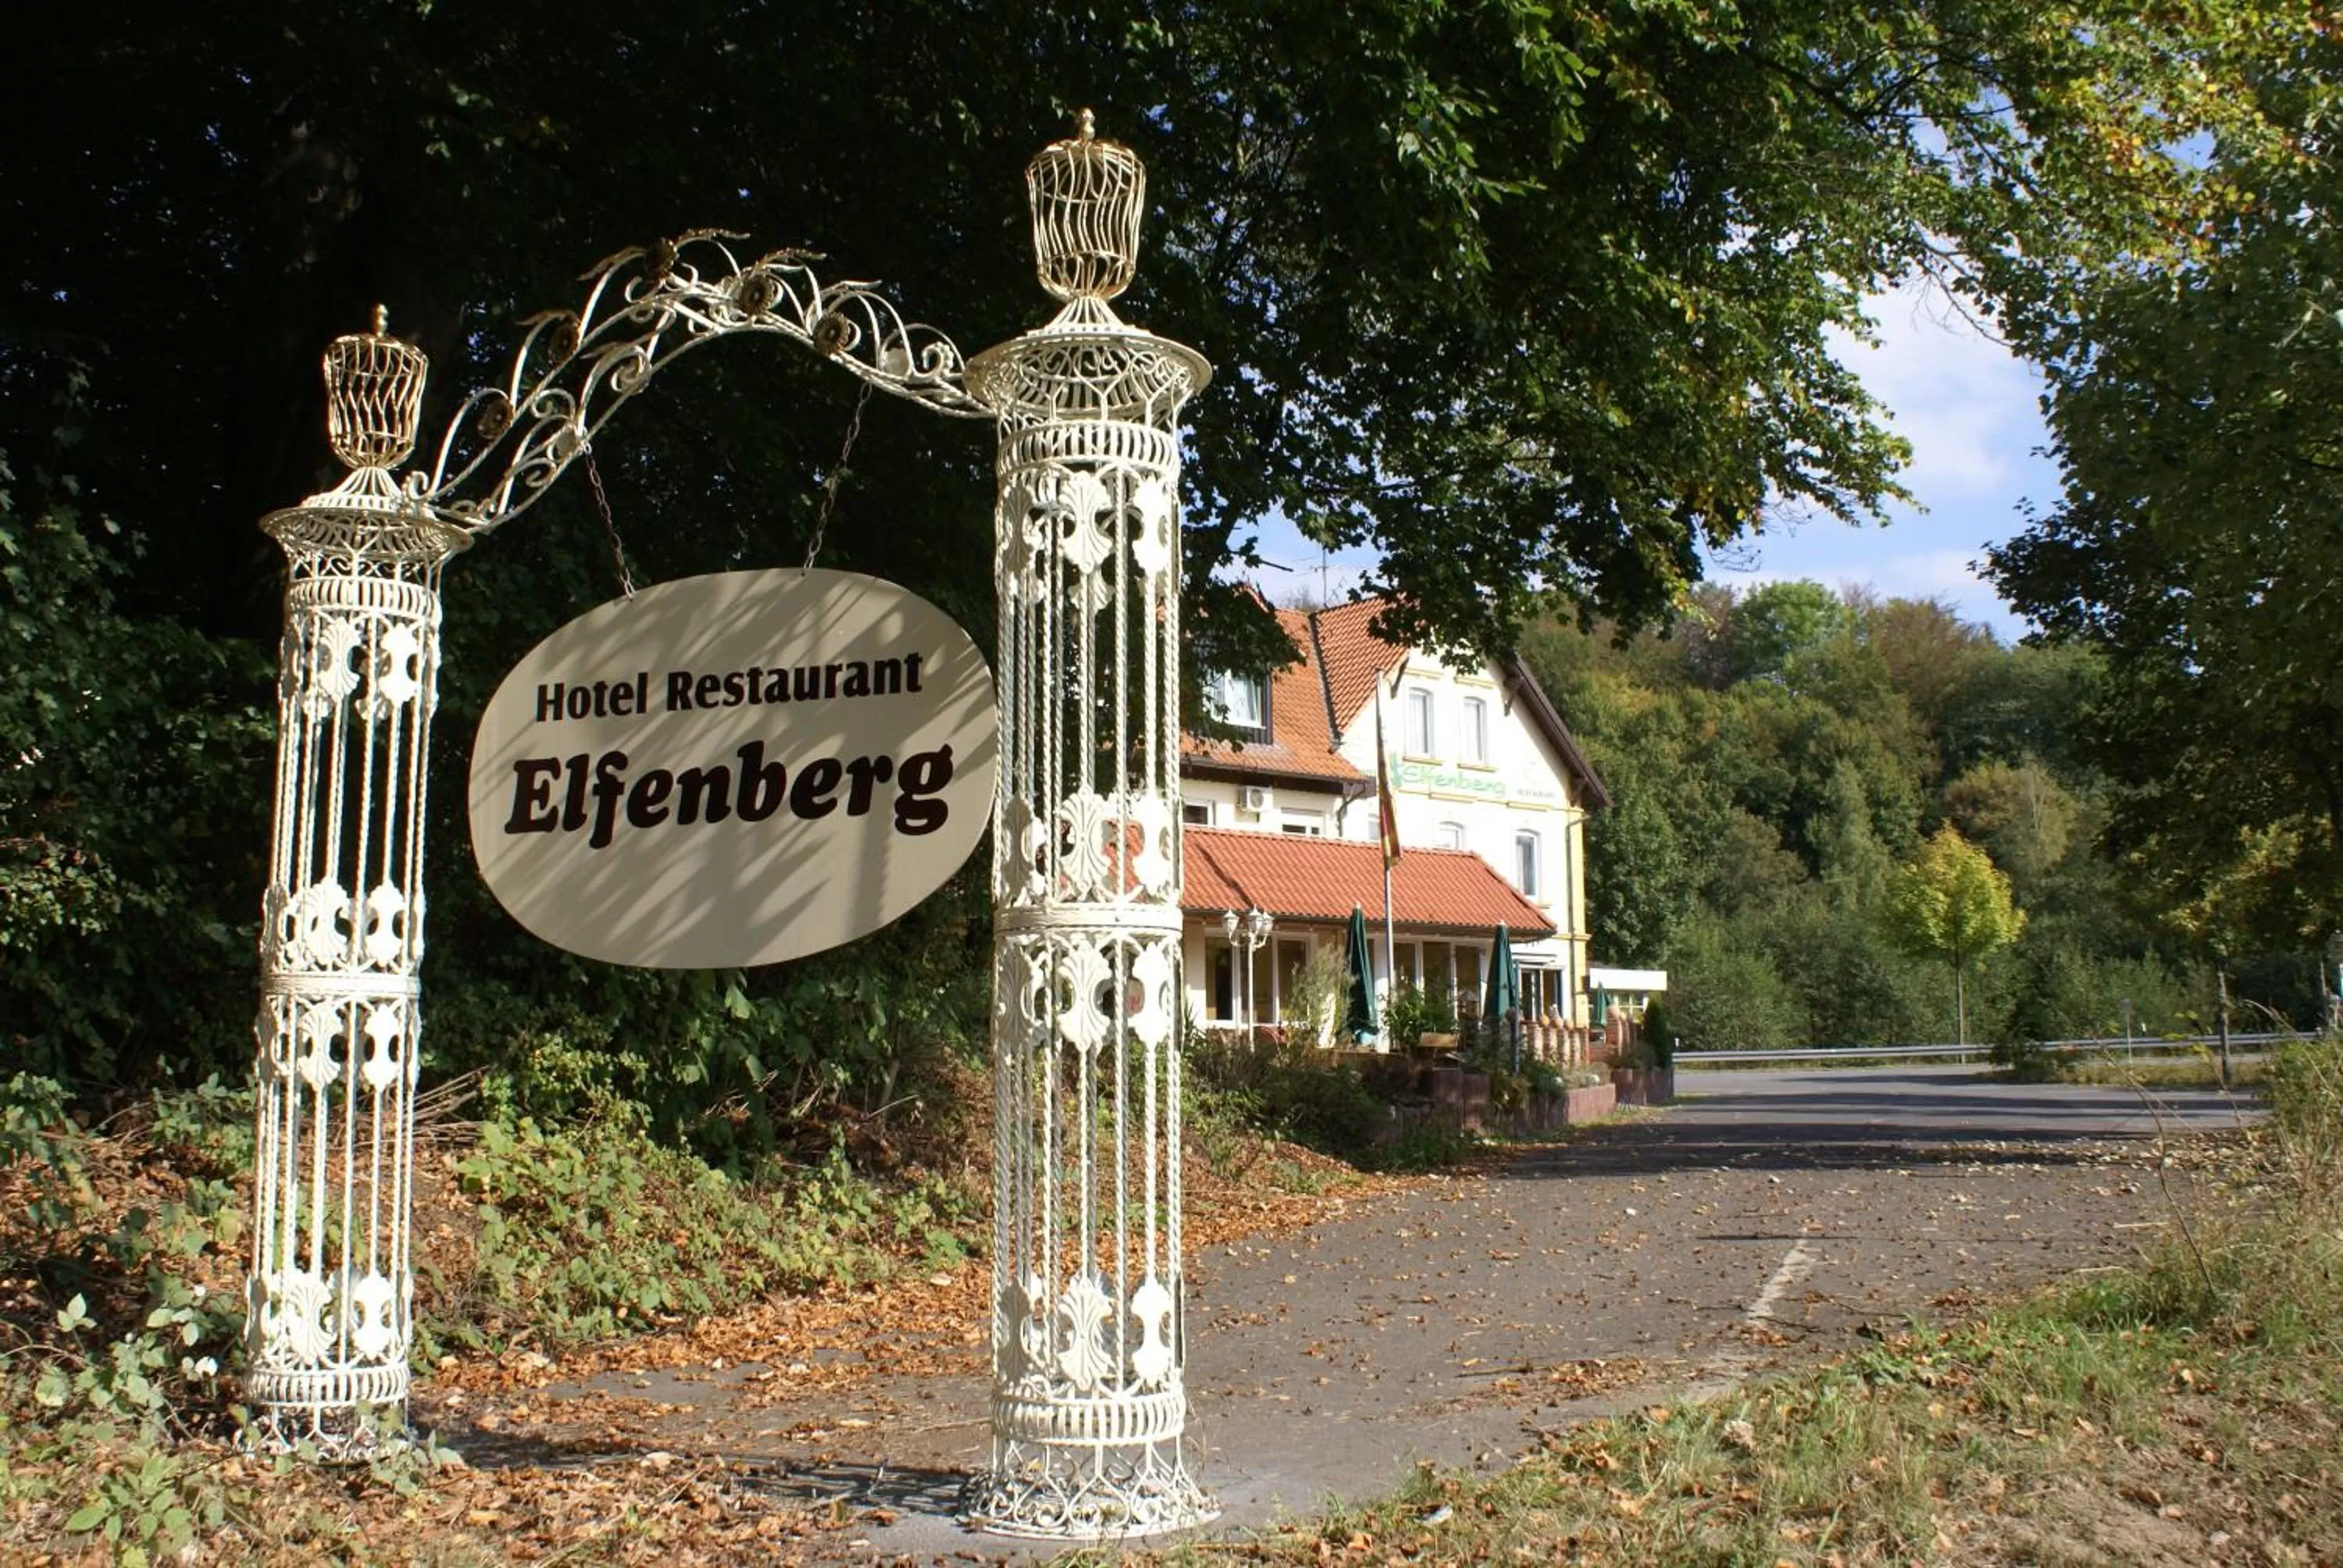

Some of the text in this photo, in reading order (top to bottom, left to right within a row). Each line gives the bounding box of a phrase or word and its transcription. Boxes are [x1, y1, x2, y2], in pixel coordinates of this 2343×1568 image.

[536, 651, 924, 722] Hotel Restaurant
[504, 739, 954, 850] Elfenberg
[1401, 764, 1506, 797] Elfenberg
